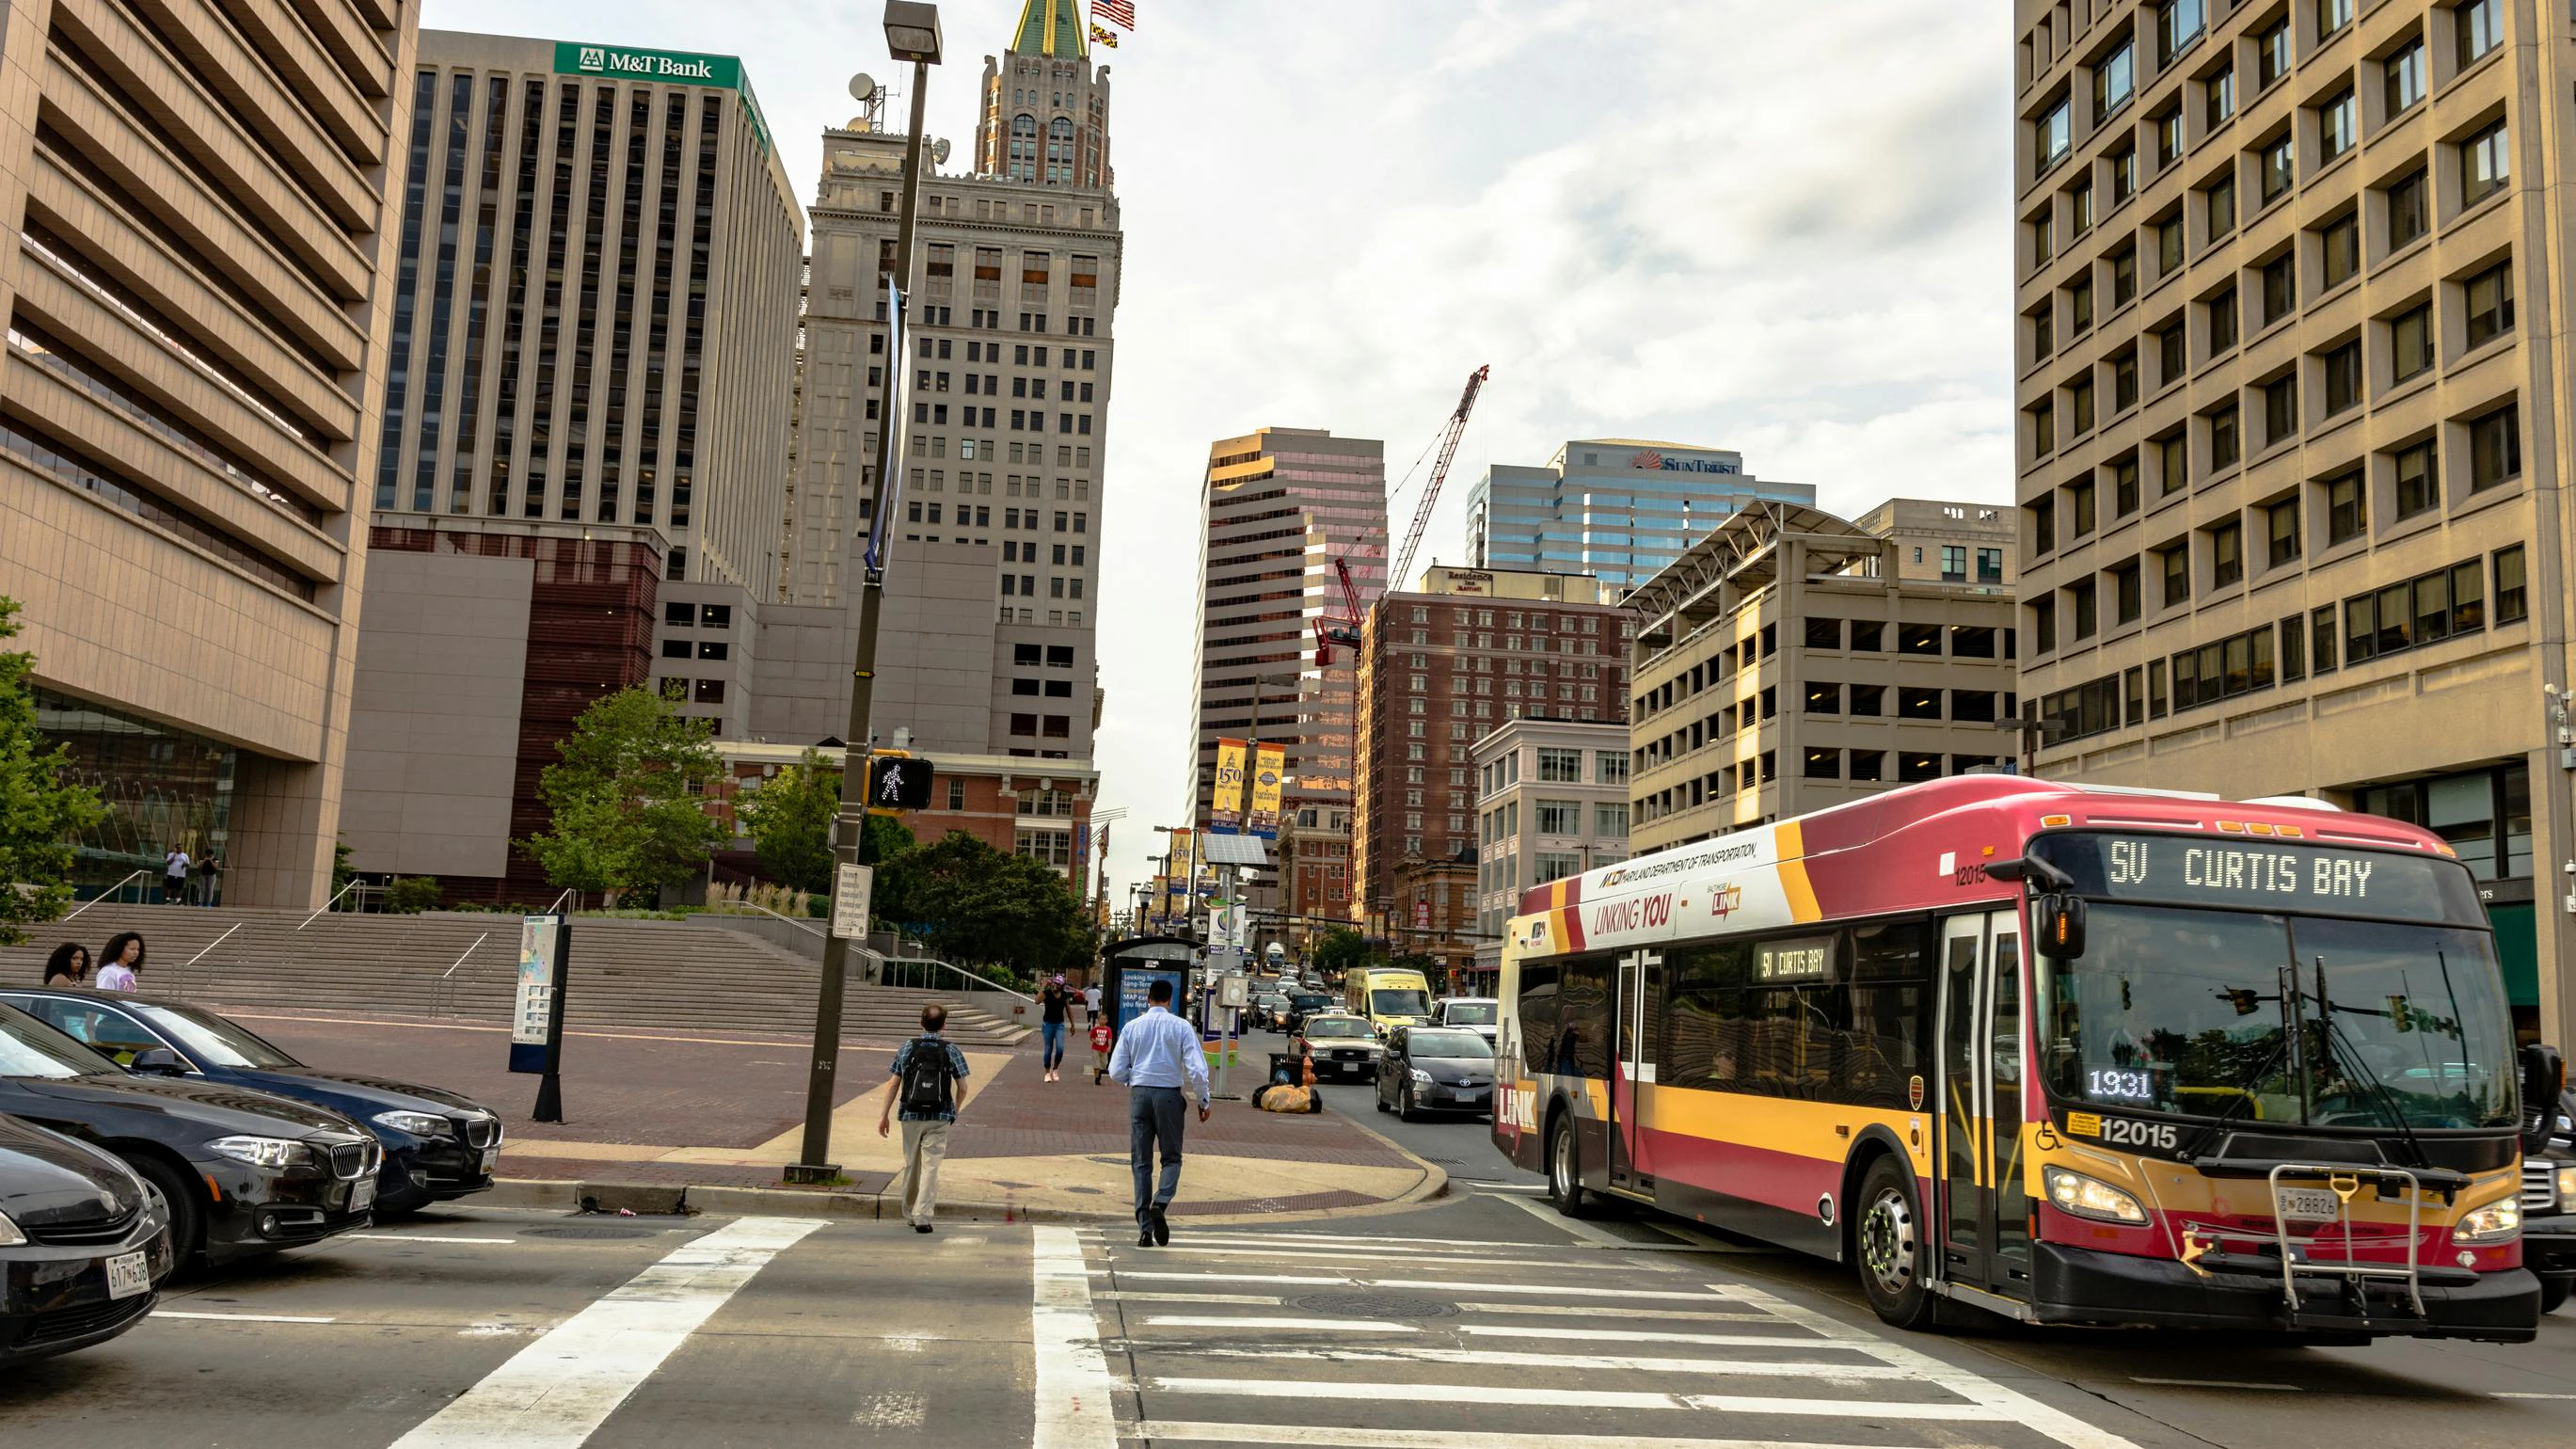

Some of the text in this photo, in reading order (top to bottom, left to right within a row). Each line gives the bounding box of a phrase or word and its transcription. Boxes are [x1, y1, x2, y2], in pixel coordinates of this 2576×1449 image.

[610, 53, 713, 79] M&T Bank
[1448, 571, 1493, 581] Residence
[1218, 767, 1242, 784] 150
[1212, 820, 1238, 829] MORGAN
[1250, 824, 1277, 833] MORGAN
[1173, 849, 1189, 861] 150
[1622, 866, 1652, 884] MARYLAND
[1649, 858, 1691, 878] DEPARTMENT
[1687, 856, 1699, 870] OF
[1697, 842, 1757, 868] TRANSPORTATION
[1955, 863, 1987, 887] 12015
[2185, 849, 2297, 892] CURTIS
[2313, 857, 2372, 898] BAY
[1713, 889, 1740, 912] LINK
[1594, 893, 1672, 936] LINKING YOU
[1778, 950, 1805, 975] CURTIS
[1807, 948, 1824, 973] BAY
[2089, 1070, 2152, 1098] 1931
[1499, 1088, 1536, 1129] LINK
[2100, 1118, 2177, 1150] 12015
[2297, 1197, 2335, 1215] 28826
